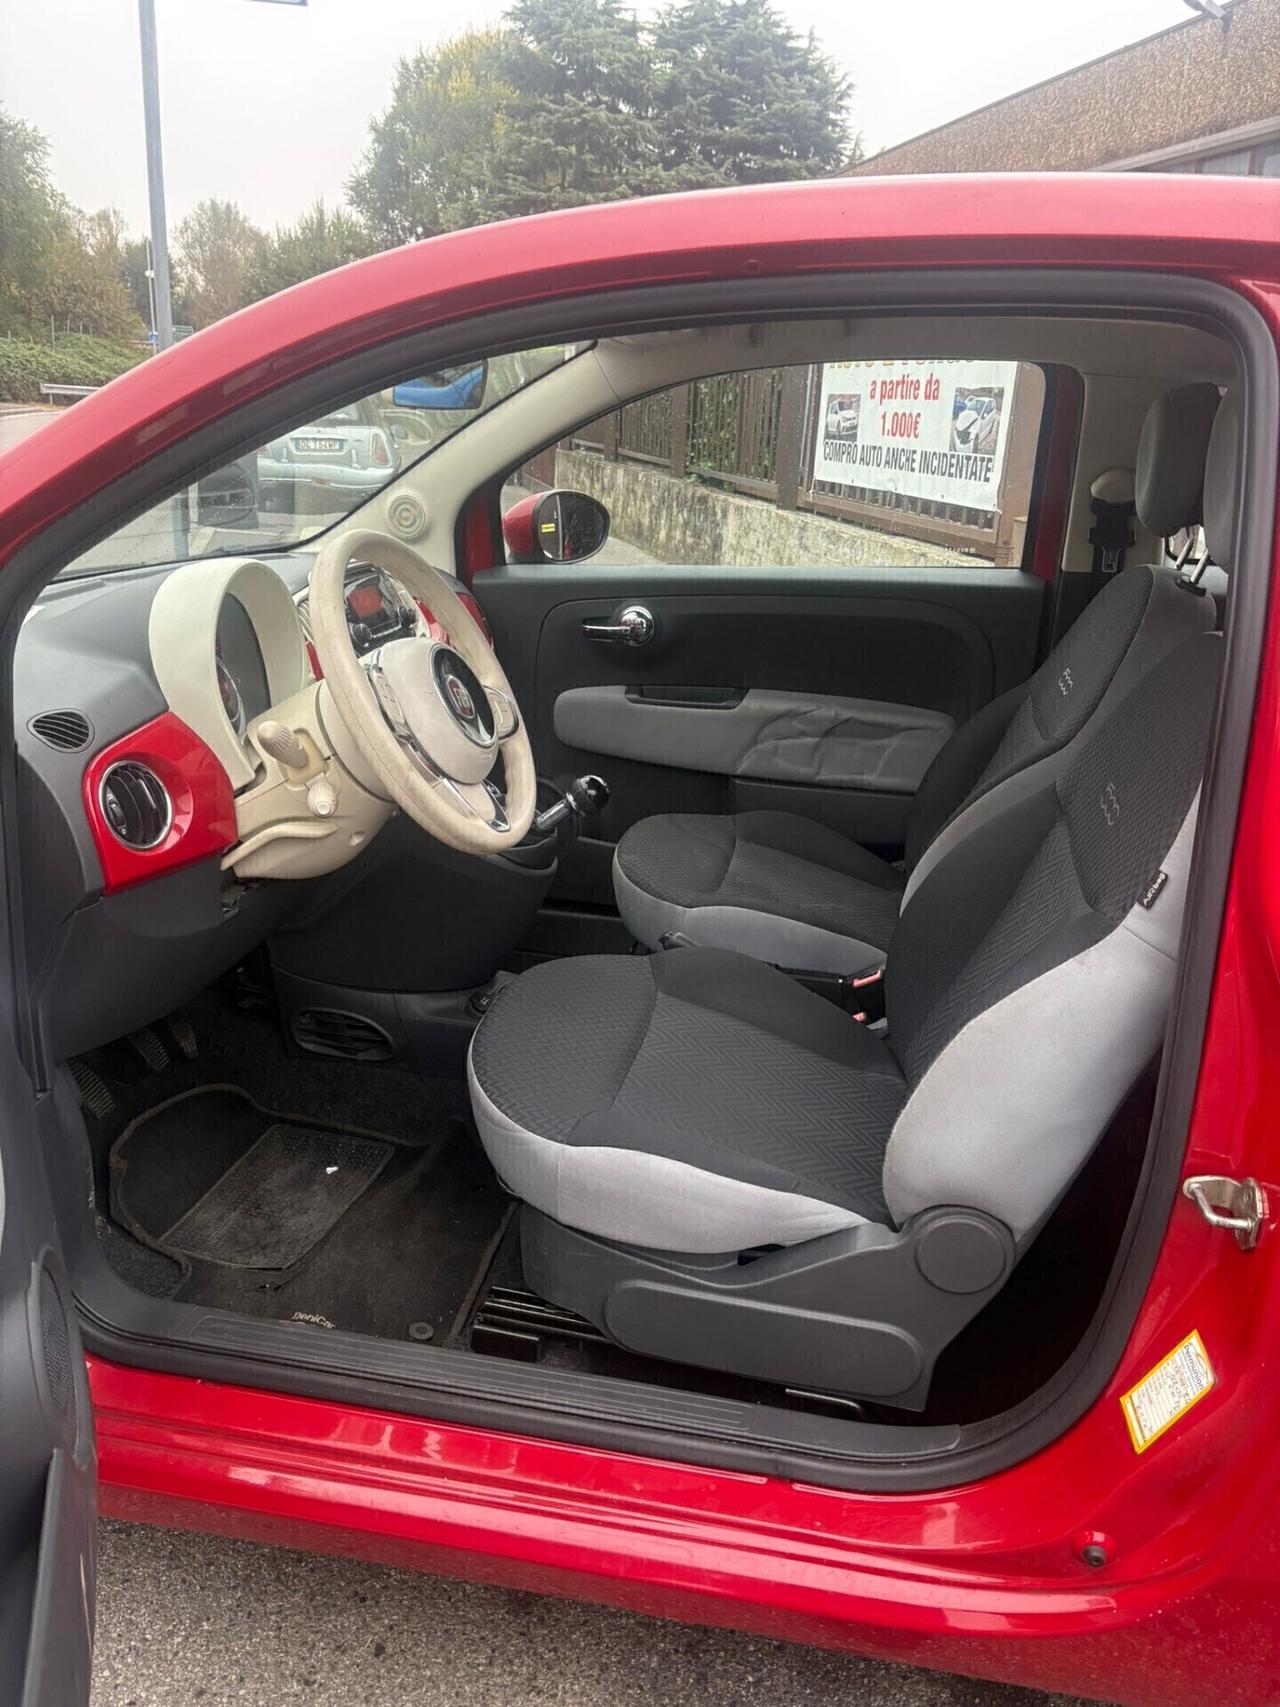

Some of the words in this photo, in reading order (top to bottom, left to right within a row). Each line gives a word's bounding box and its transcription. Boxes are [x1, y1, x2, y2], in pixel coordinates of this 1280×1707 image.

[870, 378, 876, 401] a
[879, 374, 920, 405] partire
[924, 373, 941, 401] da
[881, 411, 921, 439] 1.000€
[823, 440, 858, 465] COMPRO
[858, 444, 882, 468] AUTO
[884, 447, 916, 473] ANCHE
[919, 450, 994, 483] INCIDENTATE
